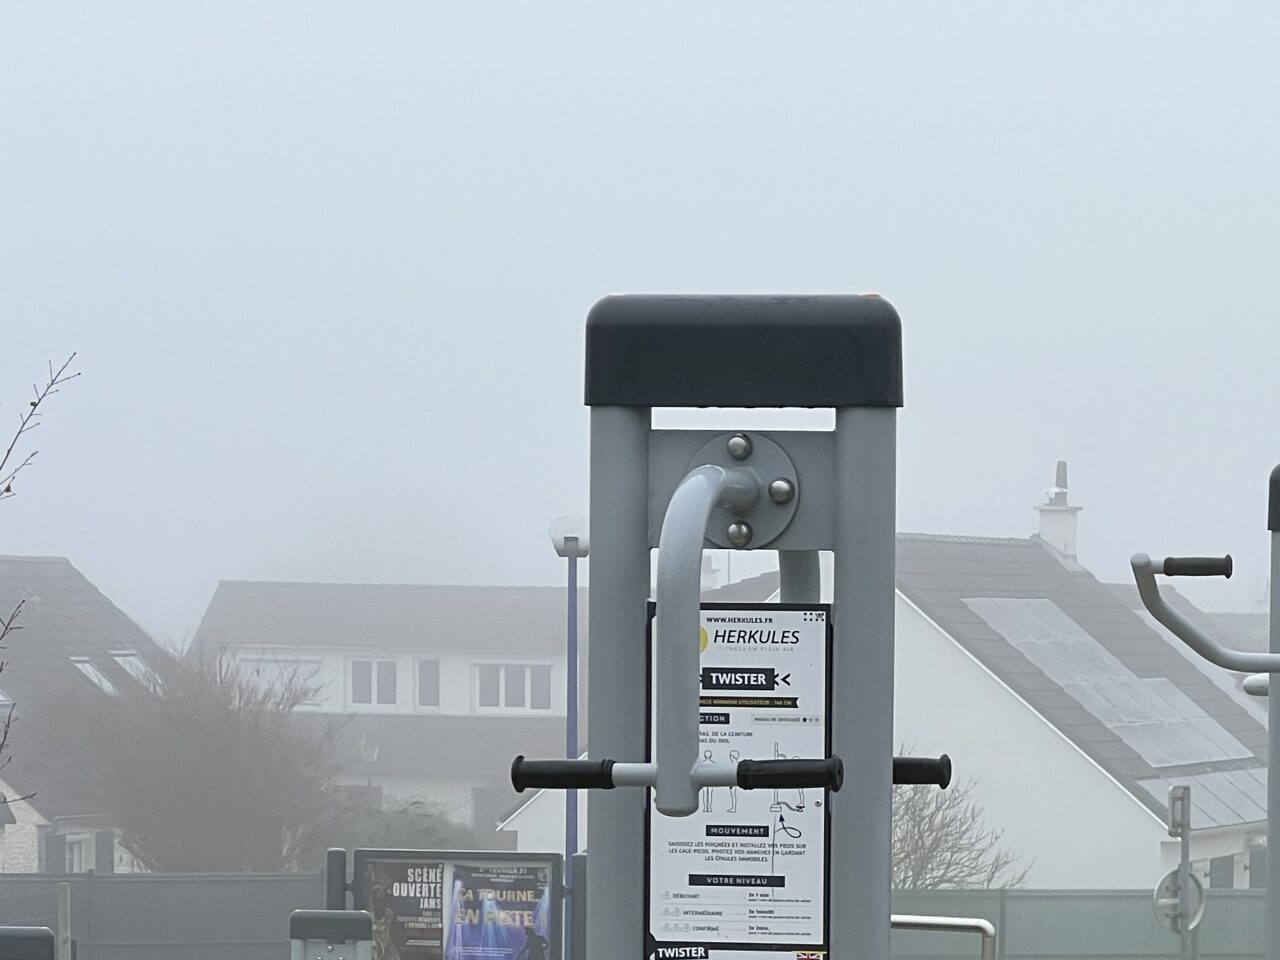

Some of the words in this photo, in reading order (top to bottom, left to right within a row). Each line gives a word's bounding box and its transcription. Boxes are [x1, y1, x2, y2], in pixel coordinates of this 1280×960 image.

[713, 630, 799, 644] HERKULES
[710, 673, 766, 685] TWISTER
[408, 866, 441, 882] SCÈNE
[393, 882, 441, 897] OUVERTE
[420, 898, 441, 909] JAMS
[456, 909, 479, 925] EN
[658, 947, 705, 958] TWISTER
